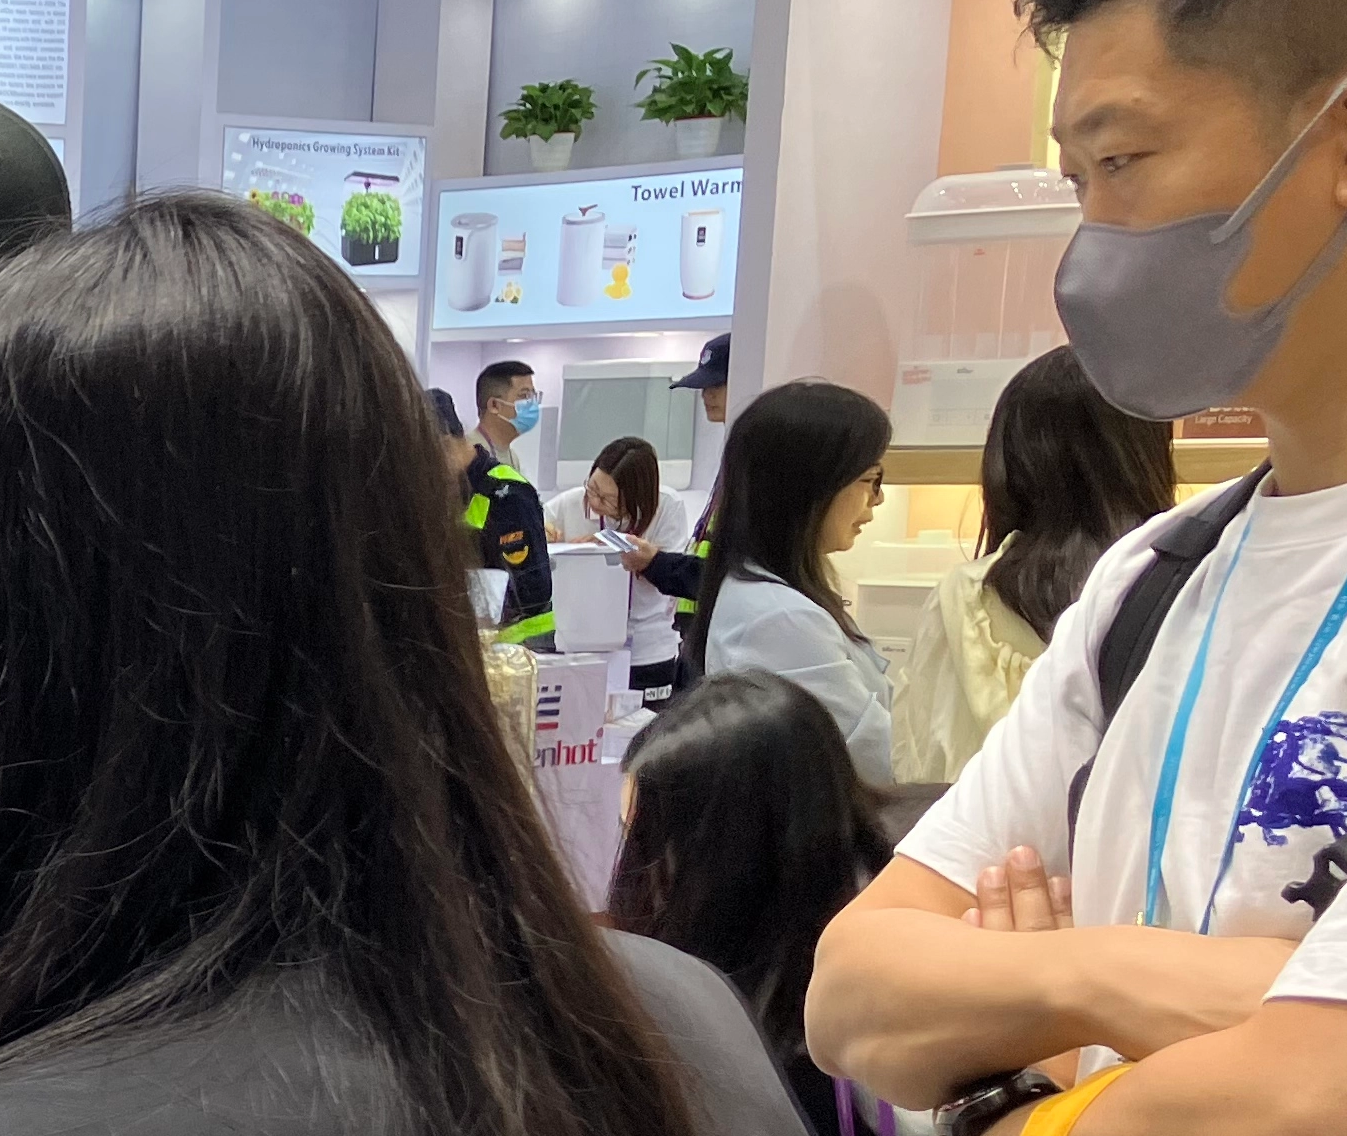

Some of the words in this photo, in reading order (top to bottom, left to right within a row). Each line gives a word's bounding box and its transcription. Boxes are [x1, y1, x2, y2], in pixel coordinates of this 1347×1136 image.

[252, 137, 311, 152] Hydroponics
[312, 141, 351, 157] Growing
[353, 143, 385, 158] System
[387, 145, 400, 157] Kit
[631, 181, 685, 202] Towel
